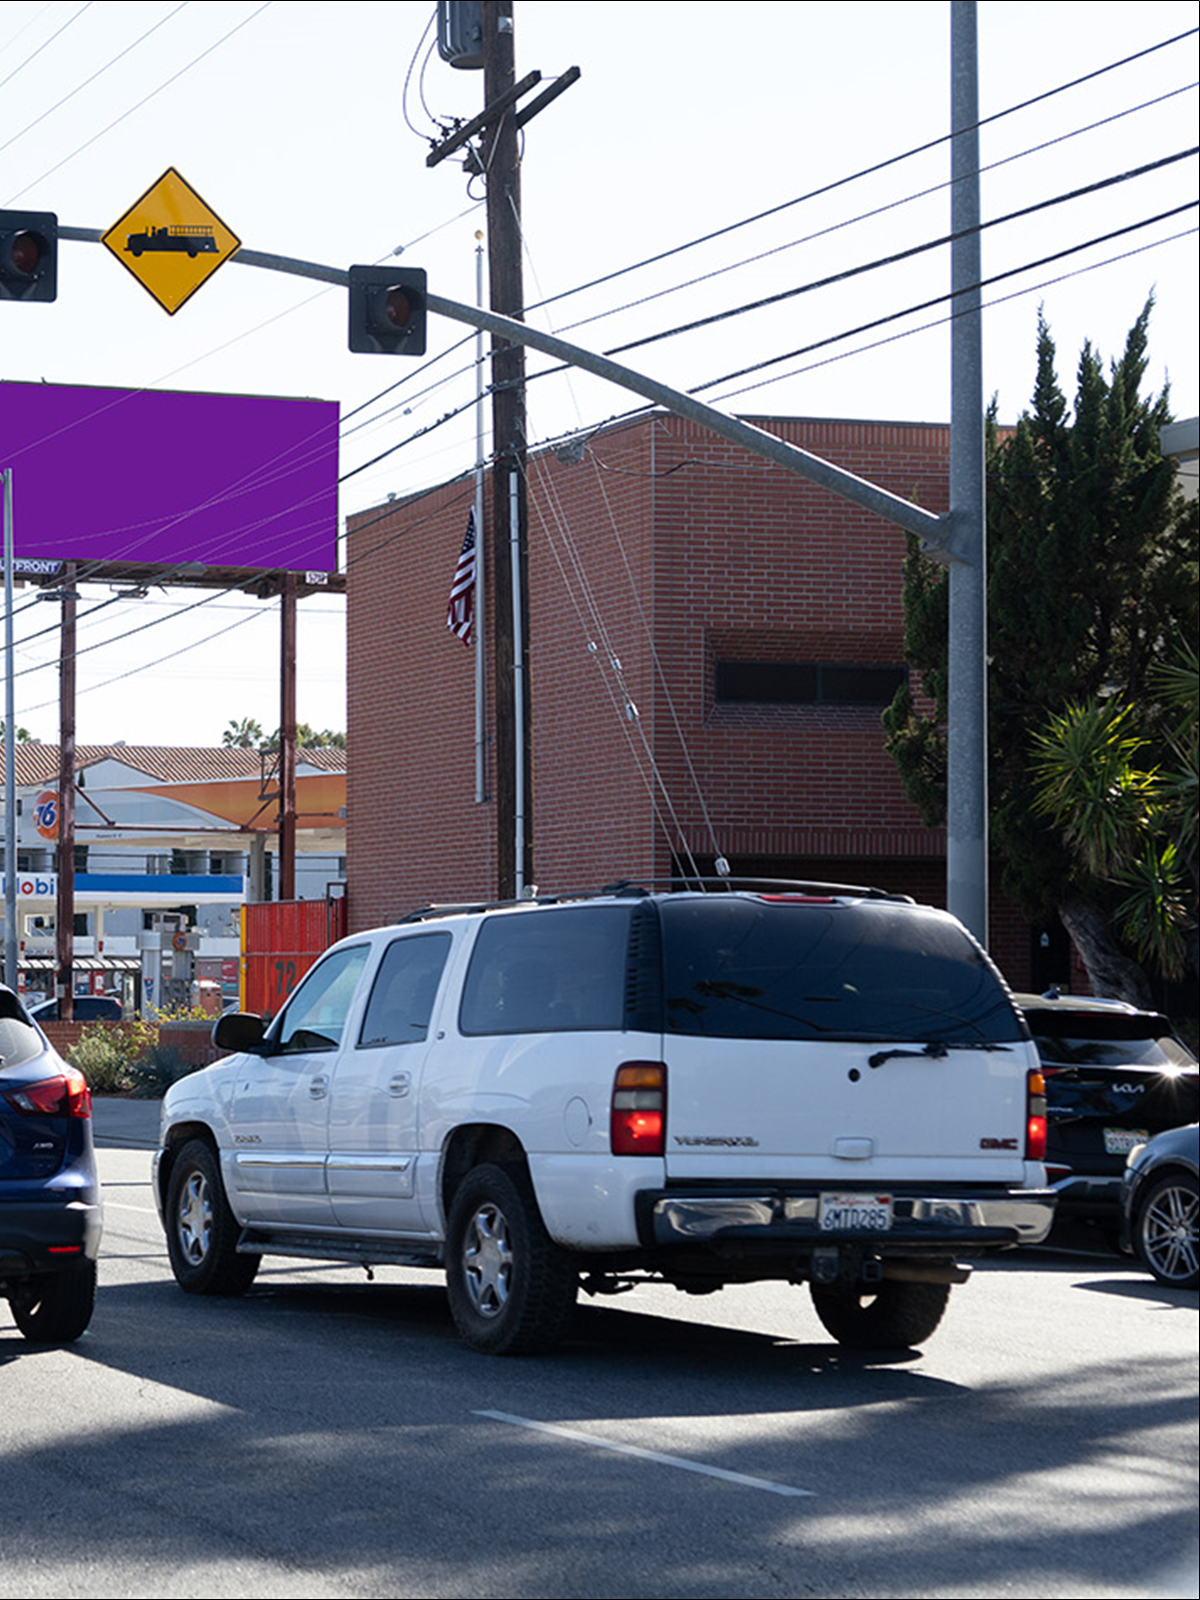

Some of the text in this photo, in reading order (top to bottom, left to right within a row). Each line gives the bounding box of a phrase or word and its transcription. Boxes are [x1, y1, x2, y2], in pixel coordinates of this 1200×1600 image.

[36, 801, 56, 827] 76
[275, 961, 296, 994] 72
[1112, 1083, 1145, 1094] KIA
[979, 1138, 1018, 1150] GMC
